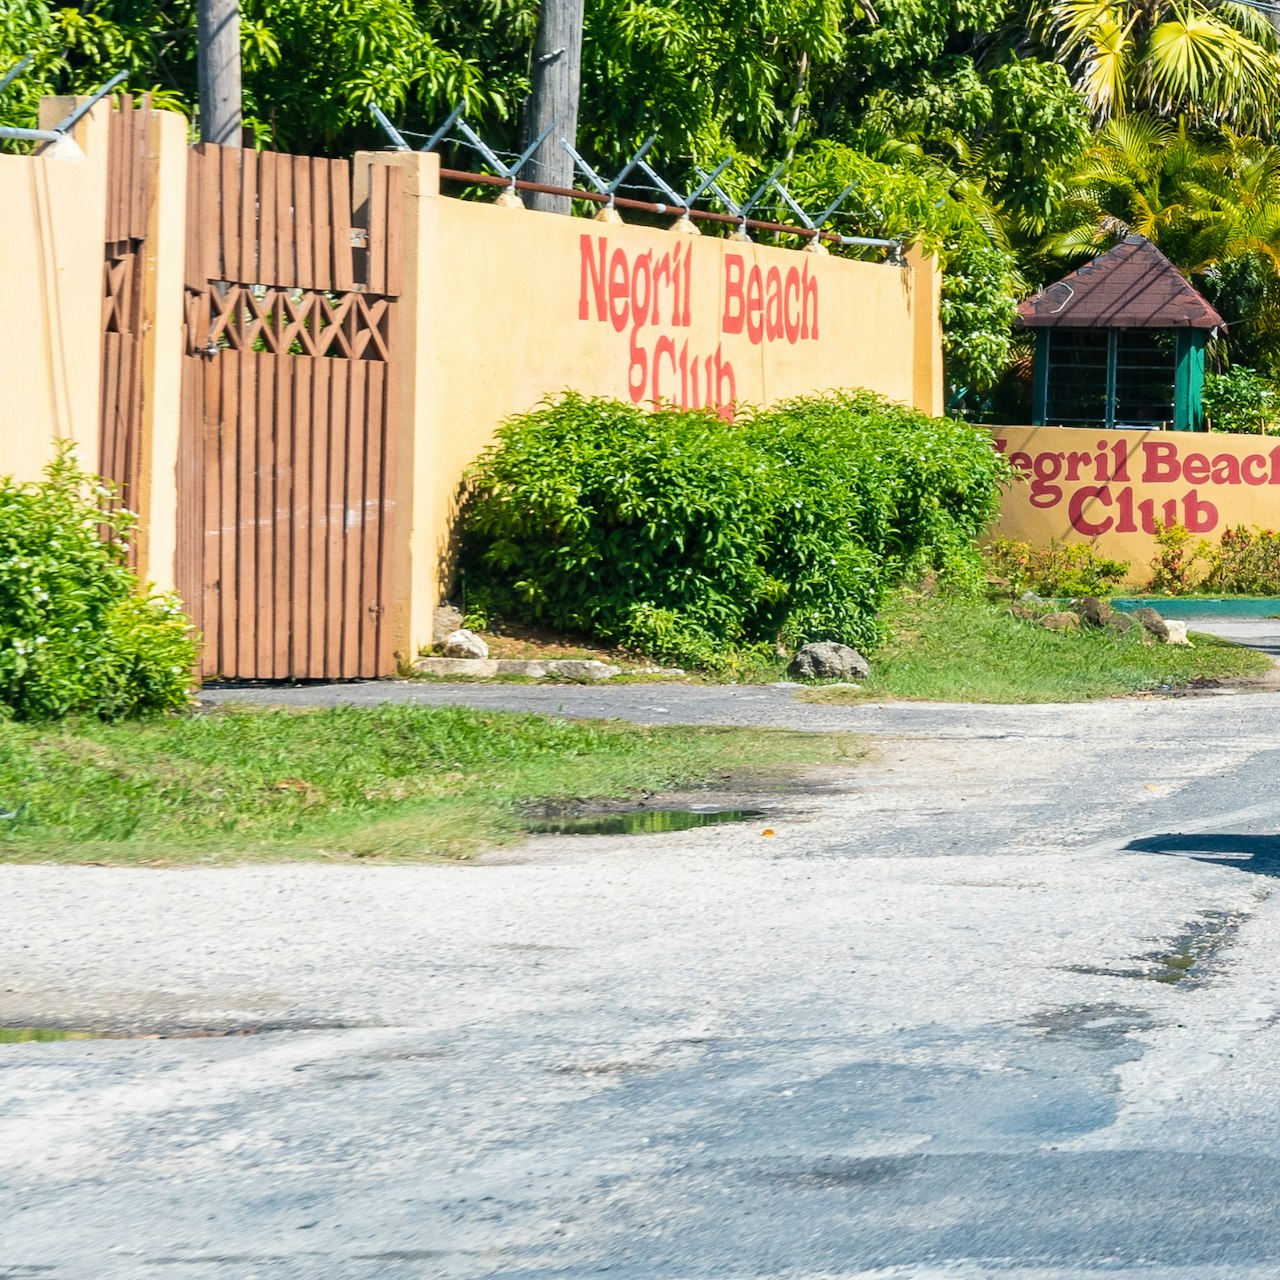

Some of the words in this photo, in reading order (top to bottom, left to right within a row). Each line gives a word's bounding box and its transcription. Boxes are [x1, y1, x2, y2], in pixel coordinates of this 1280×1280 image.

[578, 233, 693, 403] Negril
[721, 252, 820, 346] Beach
[652, 334, 736, 424] Club
[993, 438, 1131, 508] egril
[1068, 485, 1219, 536] Club
